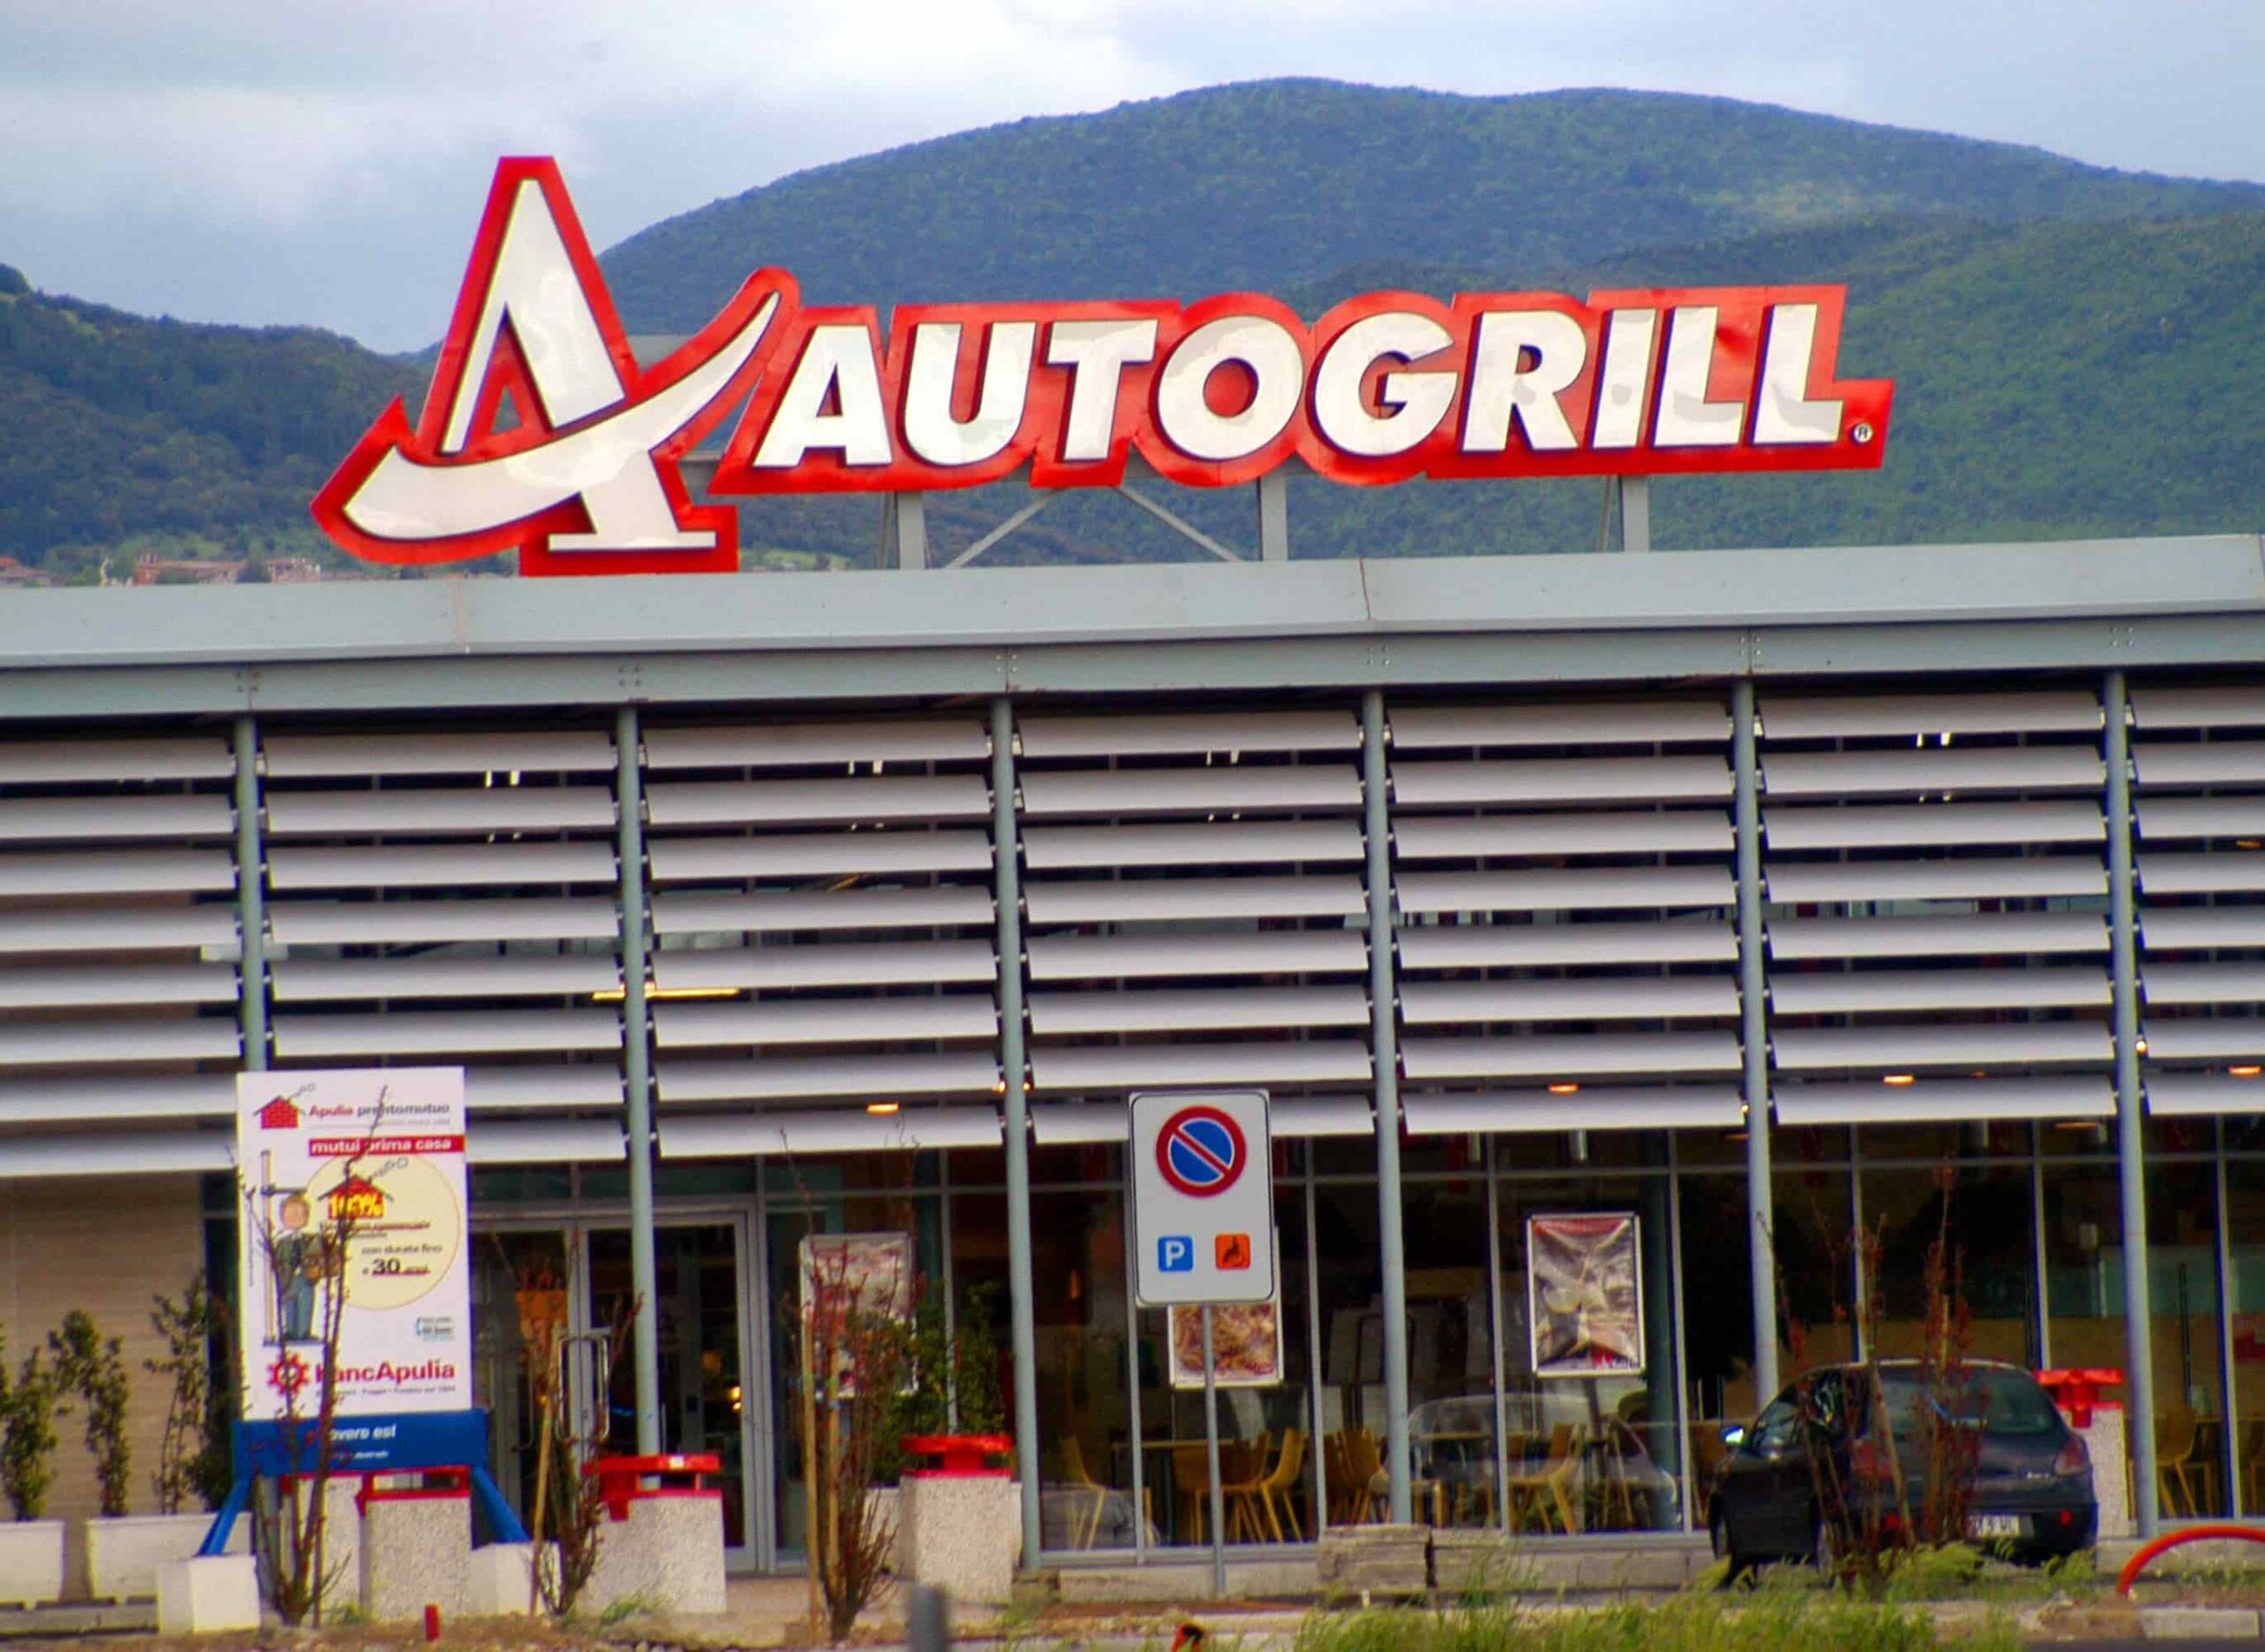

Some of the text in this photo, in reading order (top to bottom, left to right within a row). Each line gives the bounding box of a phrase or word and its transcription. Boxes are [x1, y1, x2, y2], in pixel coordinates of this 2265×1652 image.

[753, 302, 1844, 467] AUTOGRILL
[311, 1140, 360, 1153] mutui
[415, 1138, 452, 1150] casa
[372, 1257, 401, 1274] 30
[1165, 1241, 1186, 1269] P
